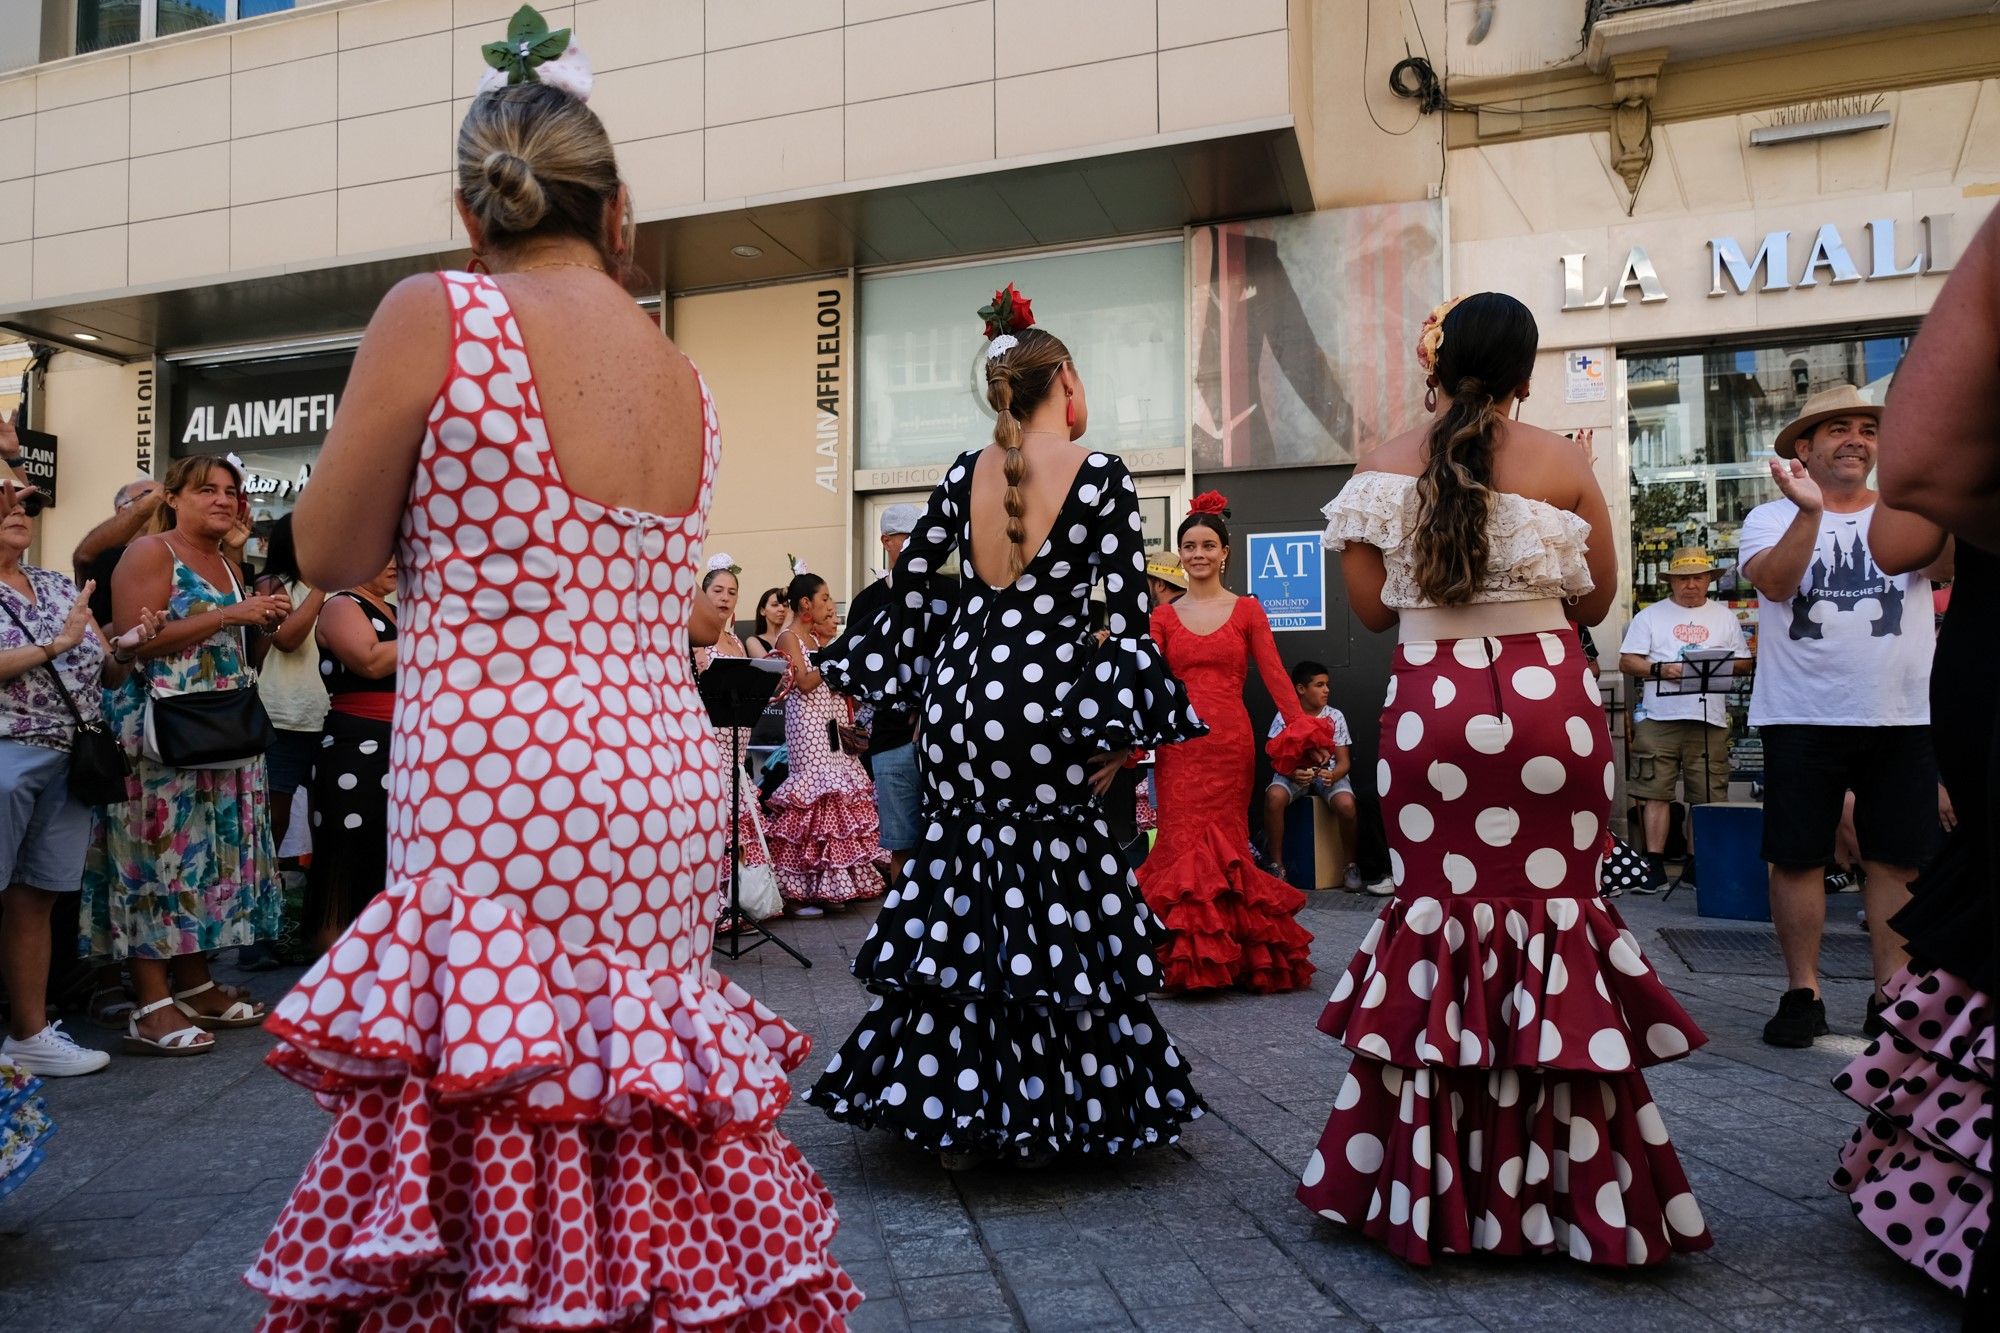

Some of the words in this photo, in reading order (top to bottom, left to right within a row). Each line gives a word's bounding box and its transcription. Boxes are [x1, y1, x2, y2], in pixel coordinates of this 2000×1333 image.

[1559, 246, 1668, 313] LA
[24, 461, 54, 478] ELOU
[872, 468, 939, 485] EDIFICIO
[1258, 542, 1315, 579] AT
[1811, 585, 1884, 598] PEPELECHES
[1263, 599, 1309, 608] CONJUNTO
